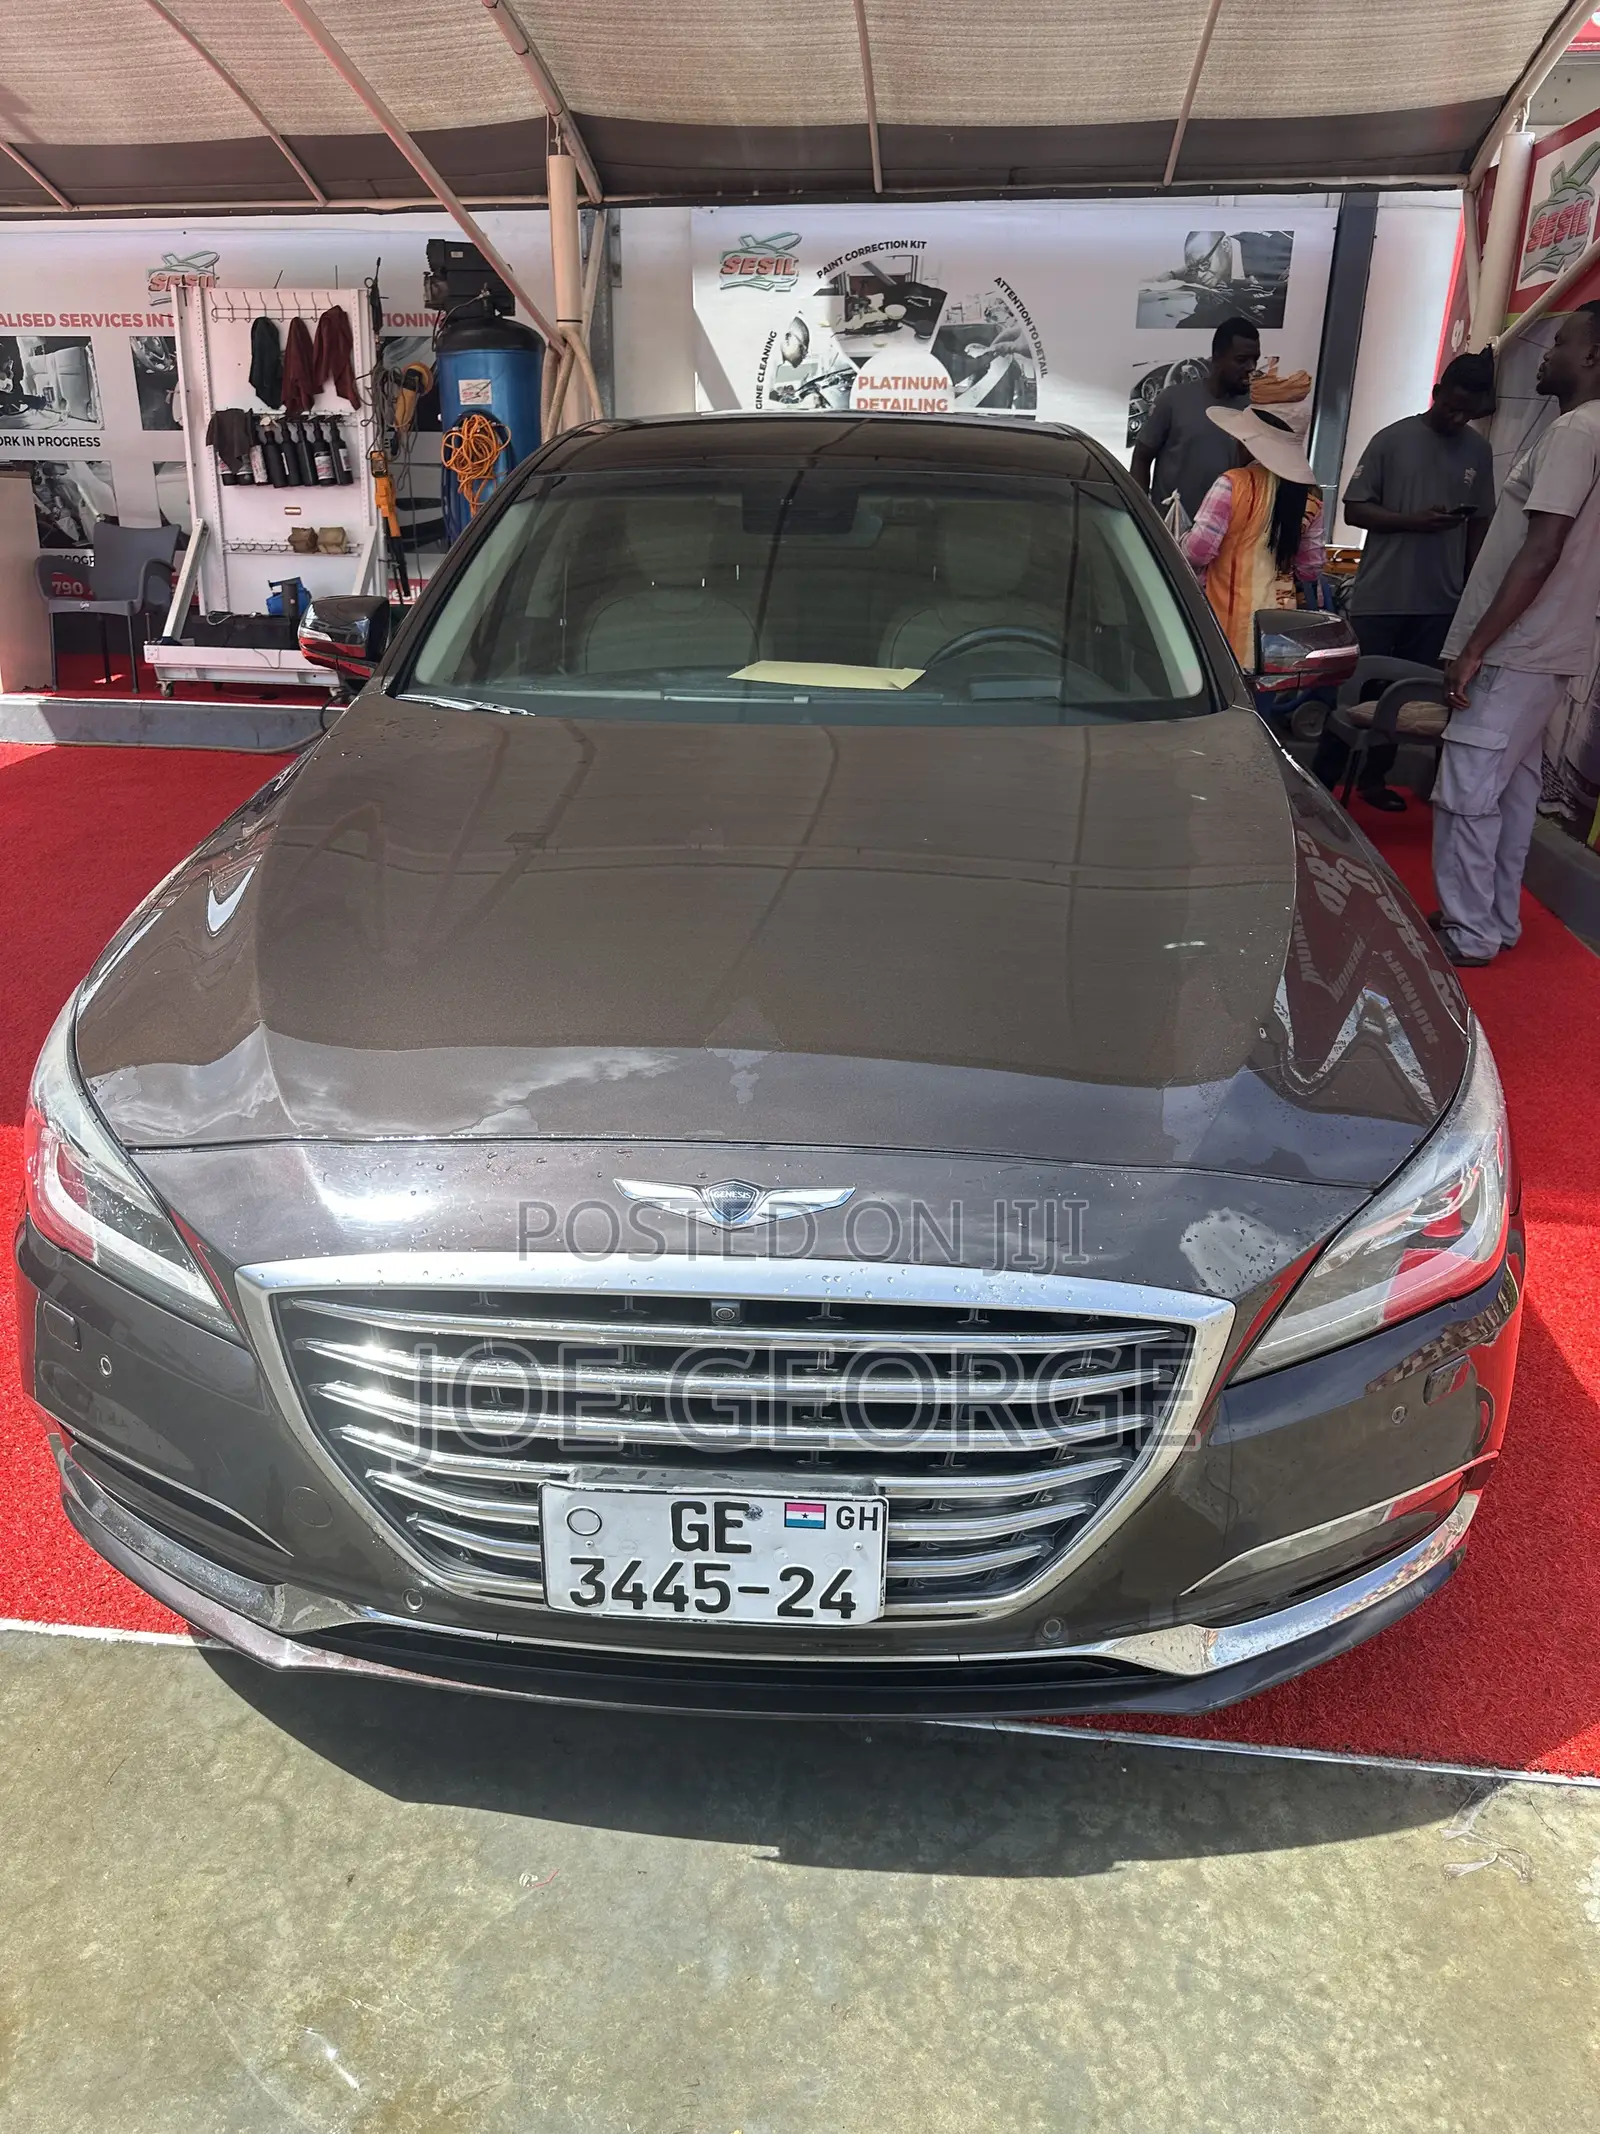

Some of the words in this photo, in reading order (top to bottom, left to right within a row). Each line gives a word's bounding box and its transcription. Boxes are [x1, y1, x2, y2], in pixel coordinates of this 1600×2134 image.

[1526, 200, 1590, 253] SESIL
[720, 255, 796, 275] SESIL
[816, 256, 844, 279] PAINT
[844, 240, 909, 262] CORRECTION
[910, 240, 927, 250] KIT
[60, 313, 143, 327] SERVICES
[146, 314, 164, 327] IN
[994, 277, 1032, 326] ATTENTION
[1029, 325, 1039, 340] TO
[1034, 341, 1048, 378] DETAIL
[757, 331, 777, 383] CLEANING
[858, 376, 948, 390] PLATINUM
[856, 397, 948, 412] DETAILING
[23, 436, 35, 447] IN
[37, 436, 101, 447] PROGRESS
[714, 1191, 751, 1199] GENESIS
[671, 1501, 752, 1553] GE
[836, 1506, 878, 1530] GH
[569, 1557, 857, 1619] 3445-24
